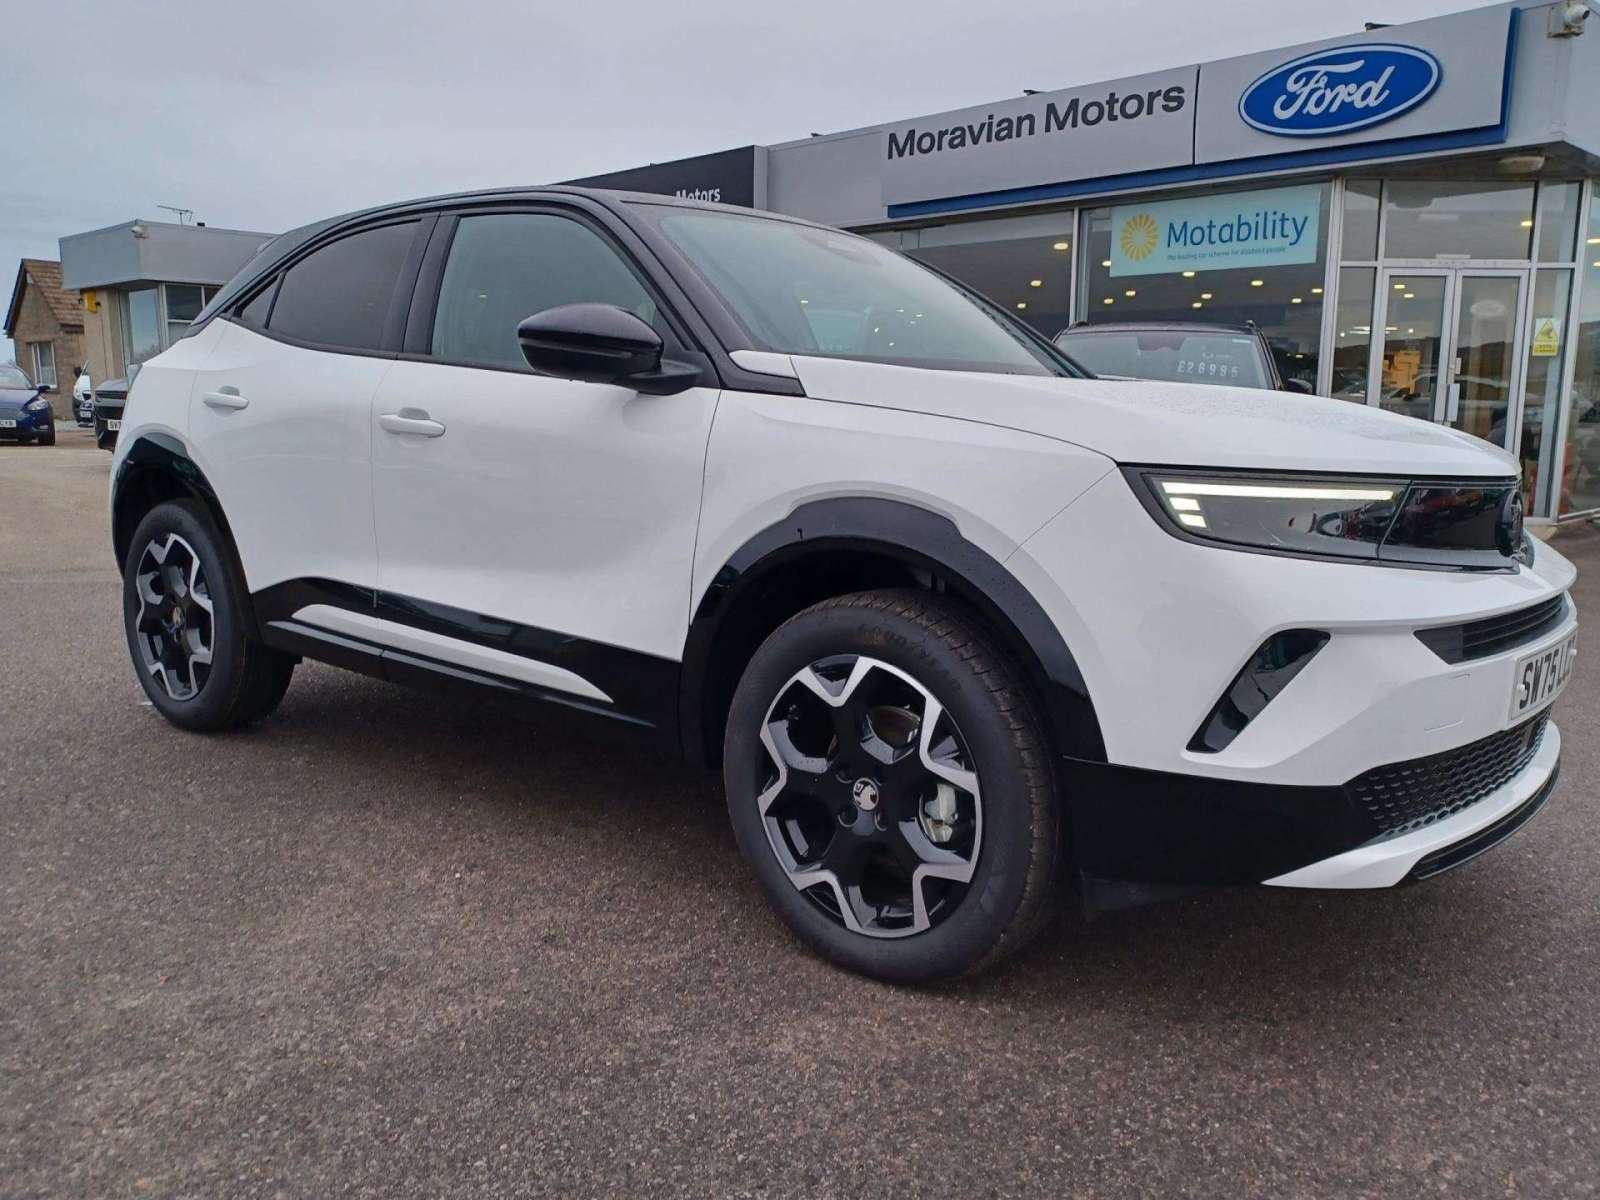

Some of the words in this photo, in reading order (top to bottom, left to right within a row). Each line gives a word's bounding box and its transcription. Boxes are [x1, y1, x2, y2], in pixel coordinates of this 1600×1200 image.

[1273, 59, 1396, 120] Ford
[887, 111, 1036, 160] Moravian
[1044, 85, 1186, 133] Motors
[675, 187, 721, 202] Motors
[1167, 210, 1309, 249] Motability
